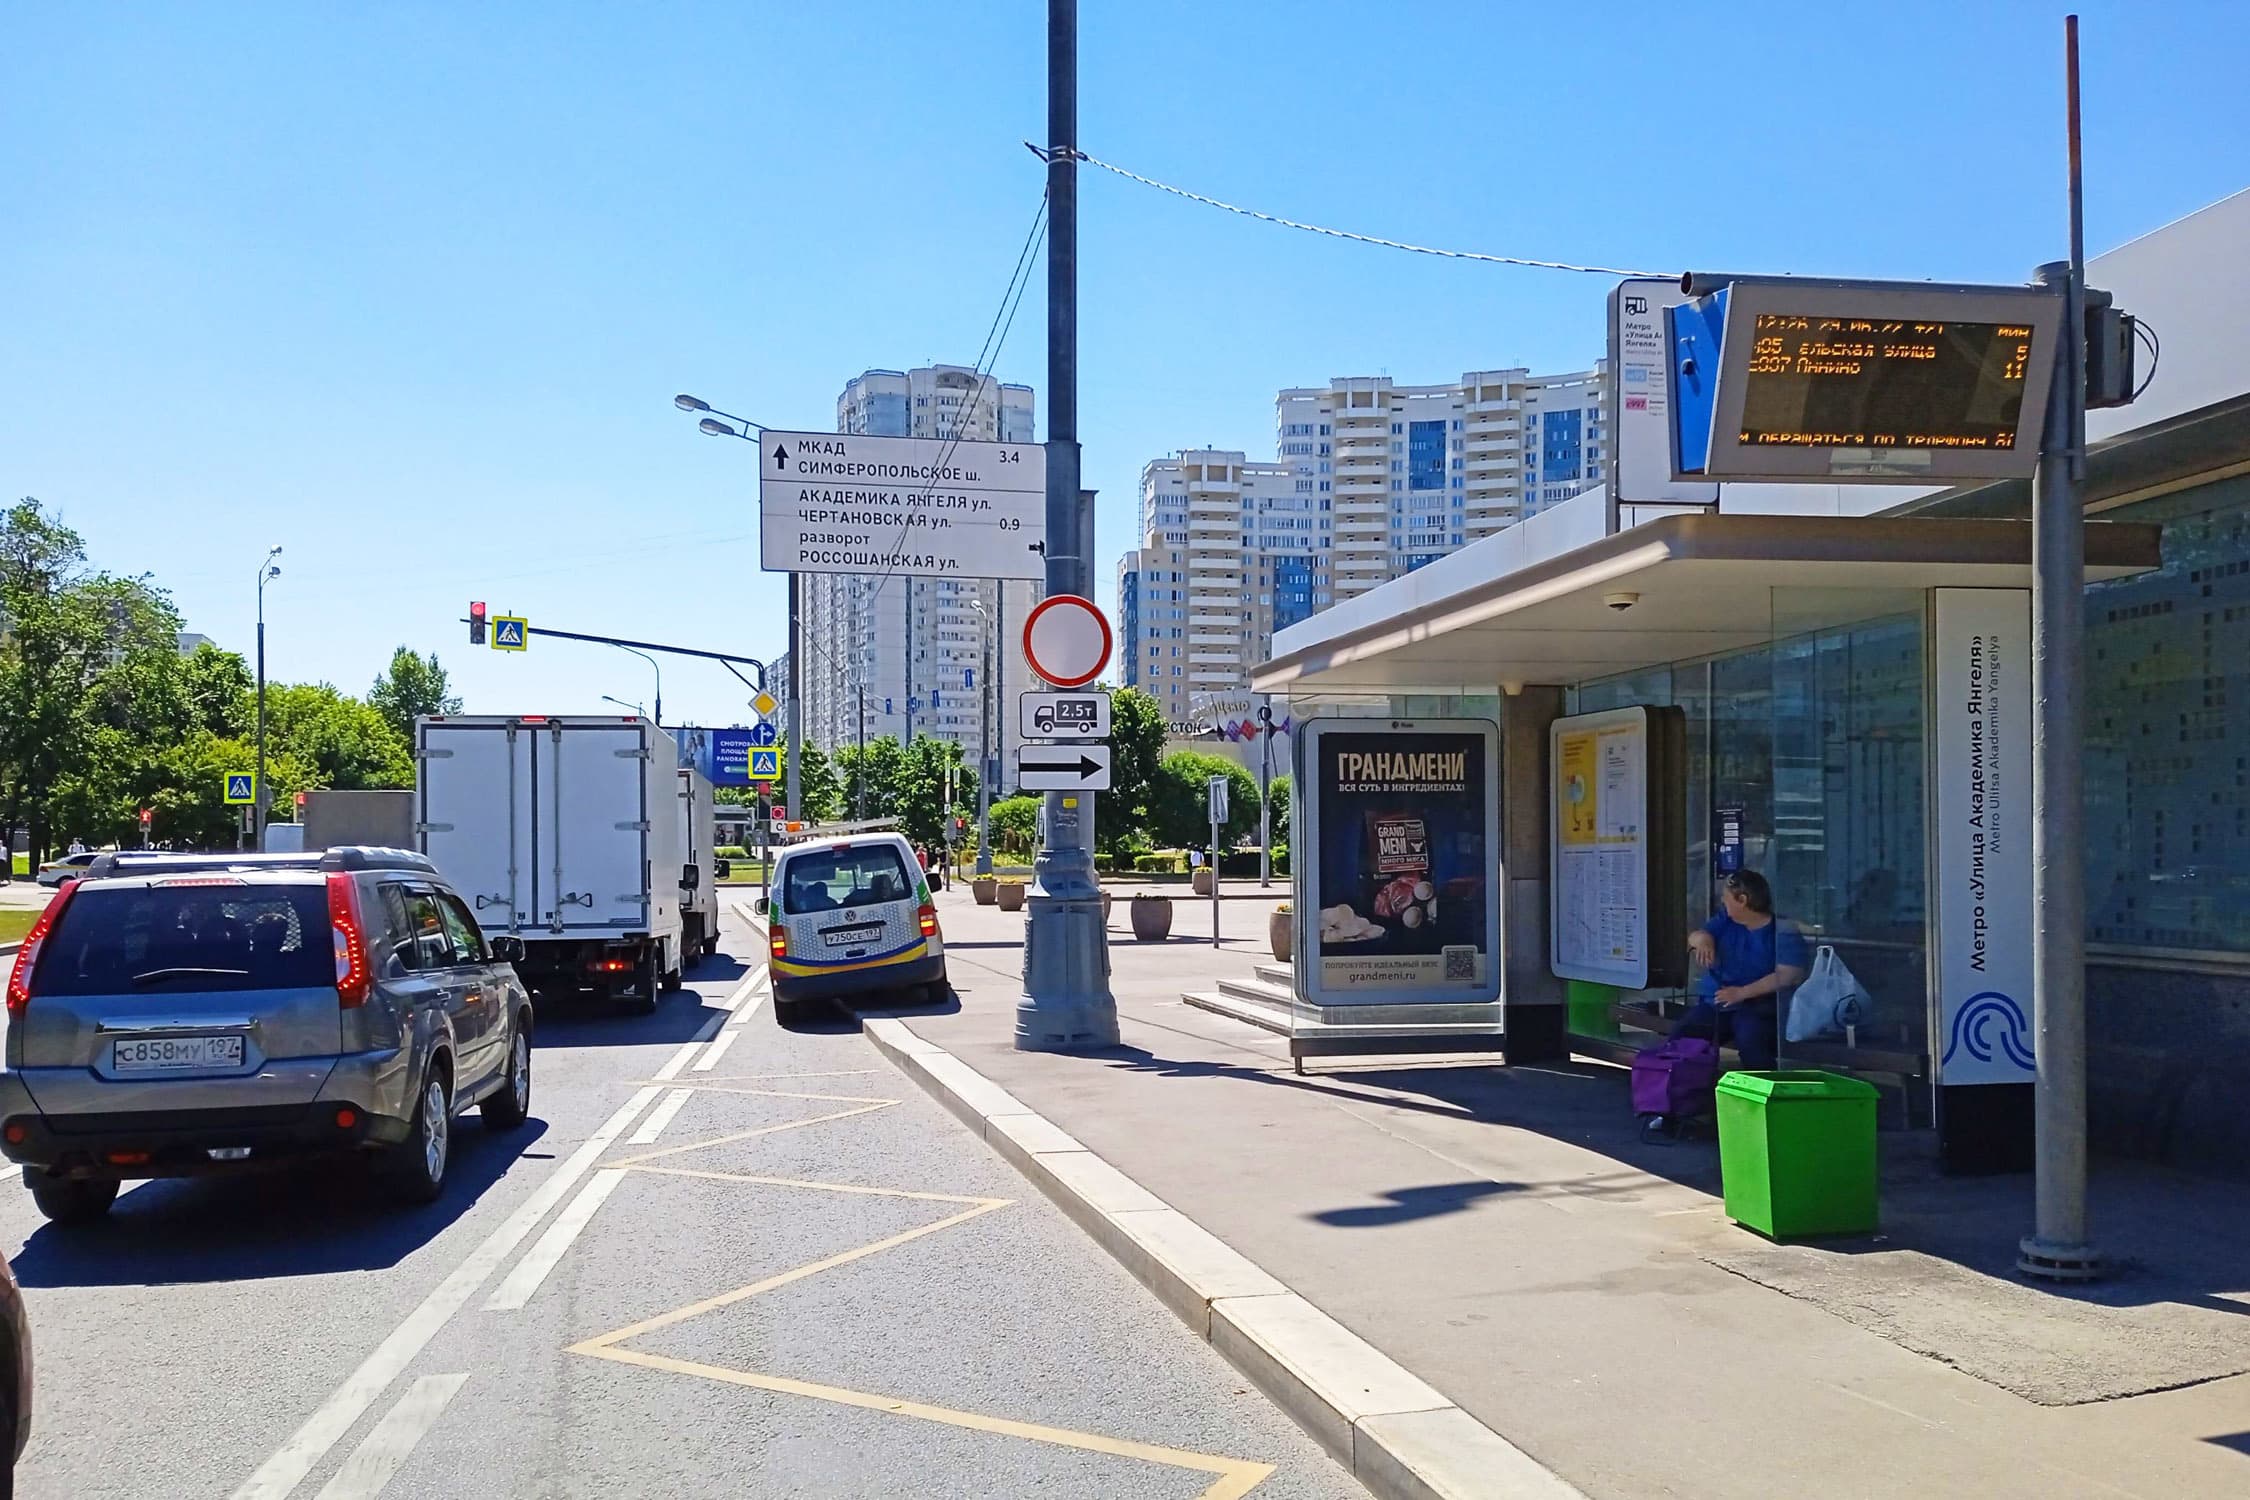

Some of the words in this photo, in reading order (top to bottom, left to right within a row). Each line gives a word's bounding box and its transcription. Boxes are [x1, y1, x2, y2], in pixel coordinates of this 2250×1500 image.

[2004, 363, 2023, 379] 11
[798, 440, 846, 456] МКАД
[999, 450, 1020, 463] 3.4
[798, 461, 961, 480] СИМФЕРОПОЛЬСКОЕ
[965, 471, 981, 481] ш.
[799, 489, 901, 505] АКАДЕМИКА
[906, 494, 967, 508] ЯНГЕЛЯ
[971, 499, 992, 512] ул.
[798, 509, 927, 527] ЧЕРТАНОВСКАЯ
[931, 517, 952, 530] ул.
[999, 518, 1020, 531] 0.9
[799, 532, 870, 547] разворот
[799, 550, 935, 568] РОССОШАНСКАЯ
[939, 559, 959, 571] ул.
[1967, 635, 1983, 714] Янгеля»
[1987, 635, 2000, 693] Yangelya
[1061, 704, 1093, 718] 2,5т
[1987, 697, 1999, 769] Akademika
[1338, 752, 1465, 781] ГРАНДМЕНИ
[1968, 720, 1985, 828] Академика
[1338, 783, 1356, 792] ВСЯ
[1358, 783, 1381, 793] СУТЬ
[1383, 784, 1390, 792] В
[1988, 772, 2000, 809] Ulitsa
[1378, 826, 1405, 837] GRAND
[1988, 812, 2000, 854] Metro
[1379, 837, 1407, 855] MENI
[1968, 832, 1986, 901] «Улица
[1969, 906, 1988, 972] Метро
[1349, 972, 1416, 983] grandmeni.ru
